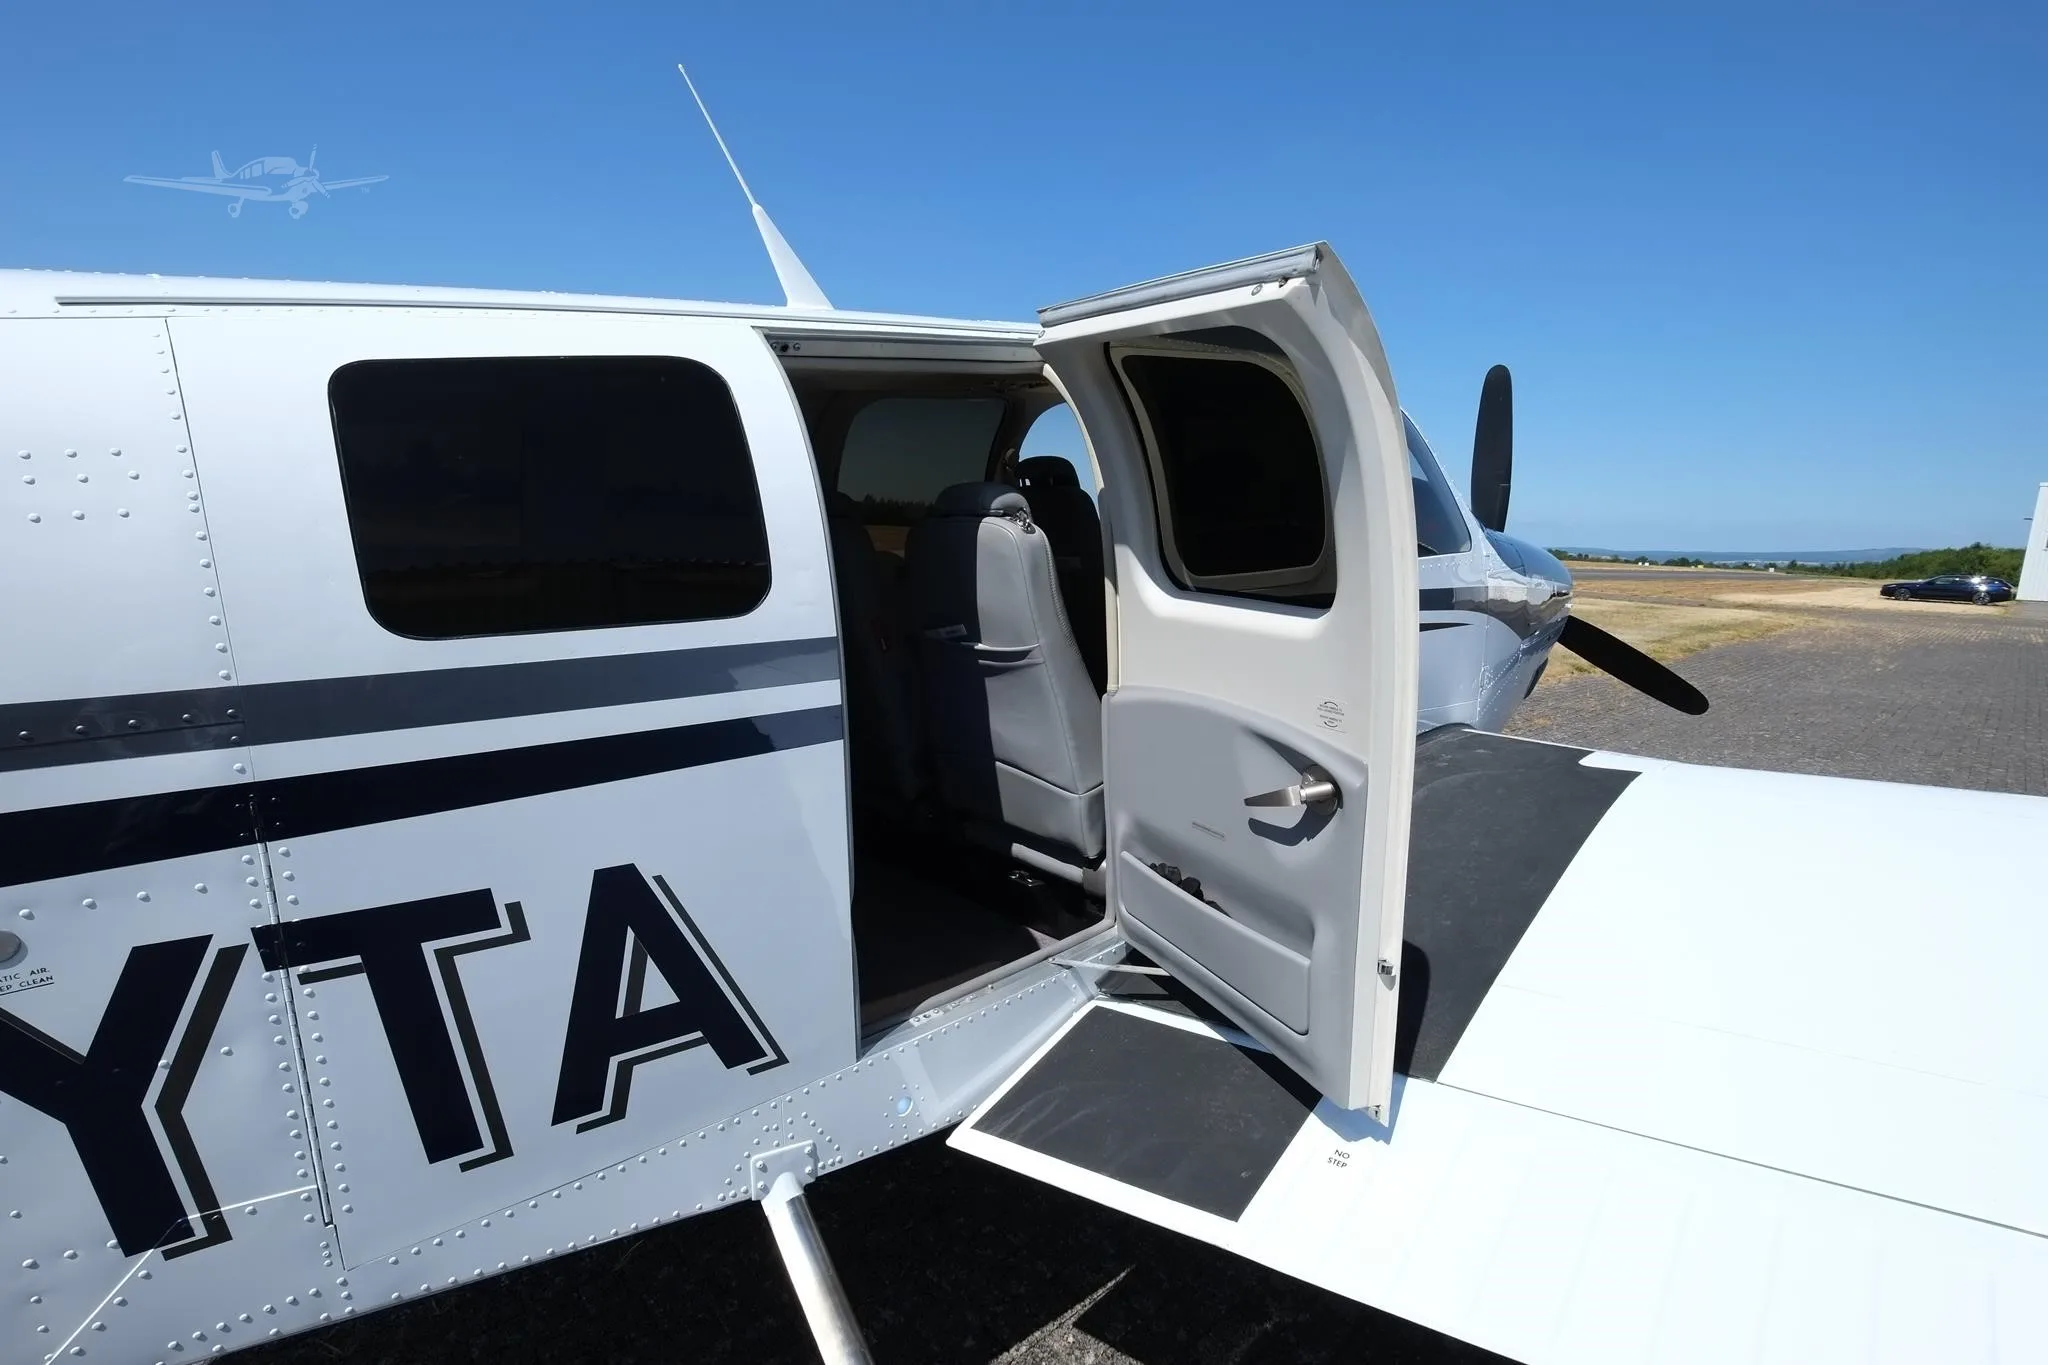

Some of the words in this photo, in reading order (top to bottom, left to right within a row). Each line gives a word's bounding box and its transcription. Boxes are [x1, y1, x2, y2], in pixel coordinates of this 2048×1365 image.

[19, 976, 54, 988] CLEAN
[0, 863, 789, 1261] YTA
[1334, 1149, 1350, 1160] NO
[1327, 1157, 1348, 1168] STEP
